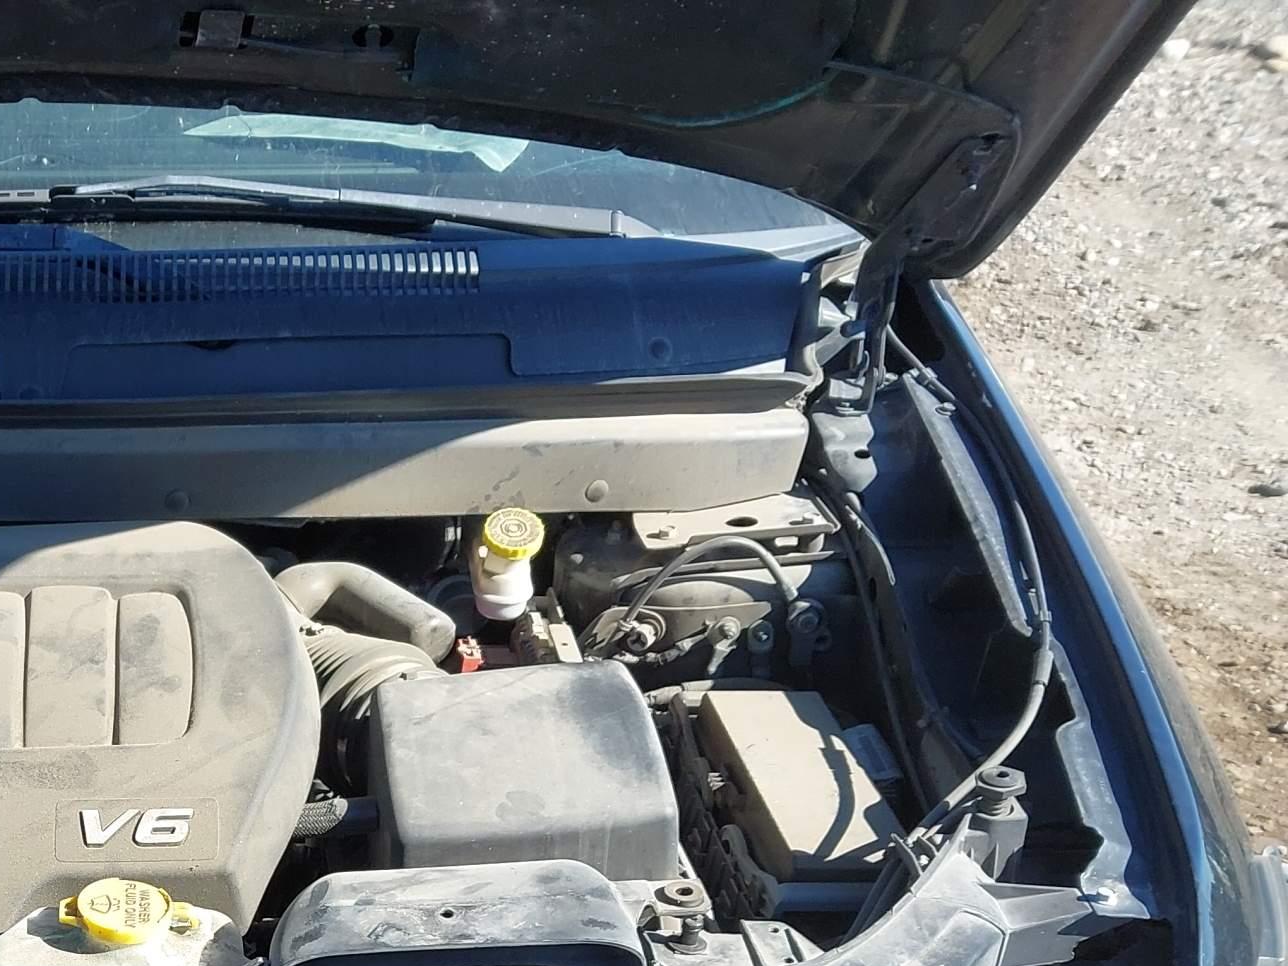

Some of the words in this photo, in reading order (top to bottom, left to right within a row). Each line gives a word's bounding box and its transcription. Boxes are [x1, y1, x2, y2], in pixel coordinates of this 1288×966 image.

[79, 808, 194, 848] V6
[124, 883, 137, 906] FLUID
[138, 889, 151, 924] WASHER
[124, 907, 137, 929] ONLY
